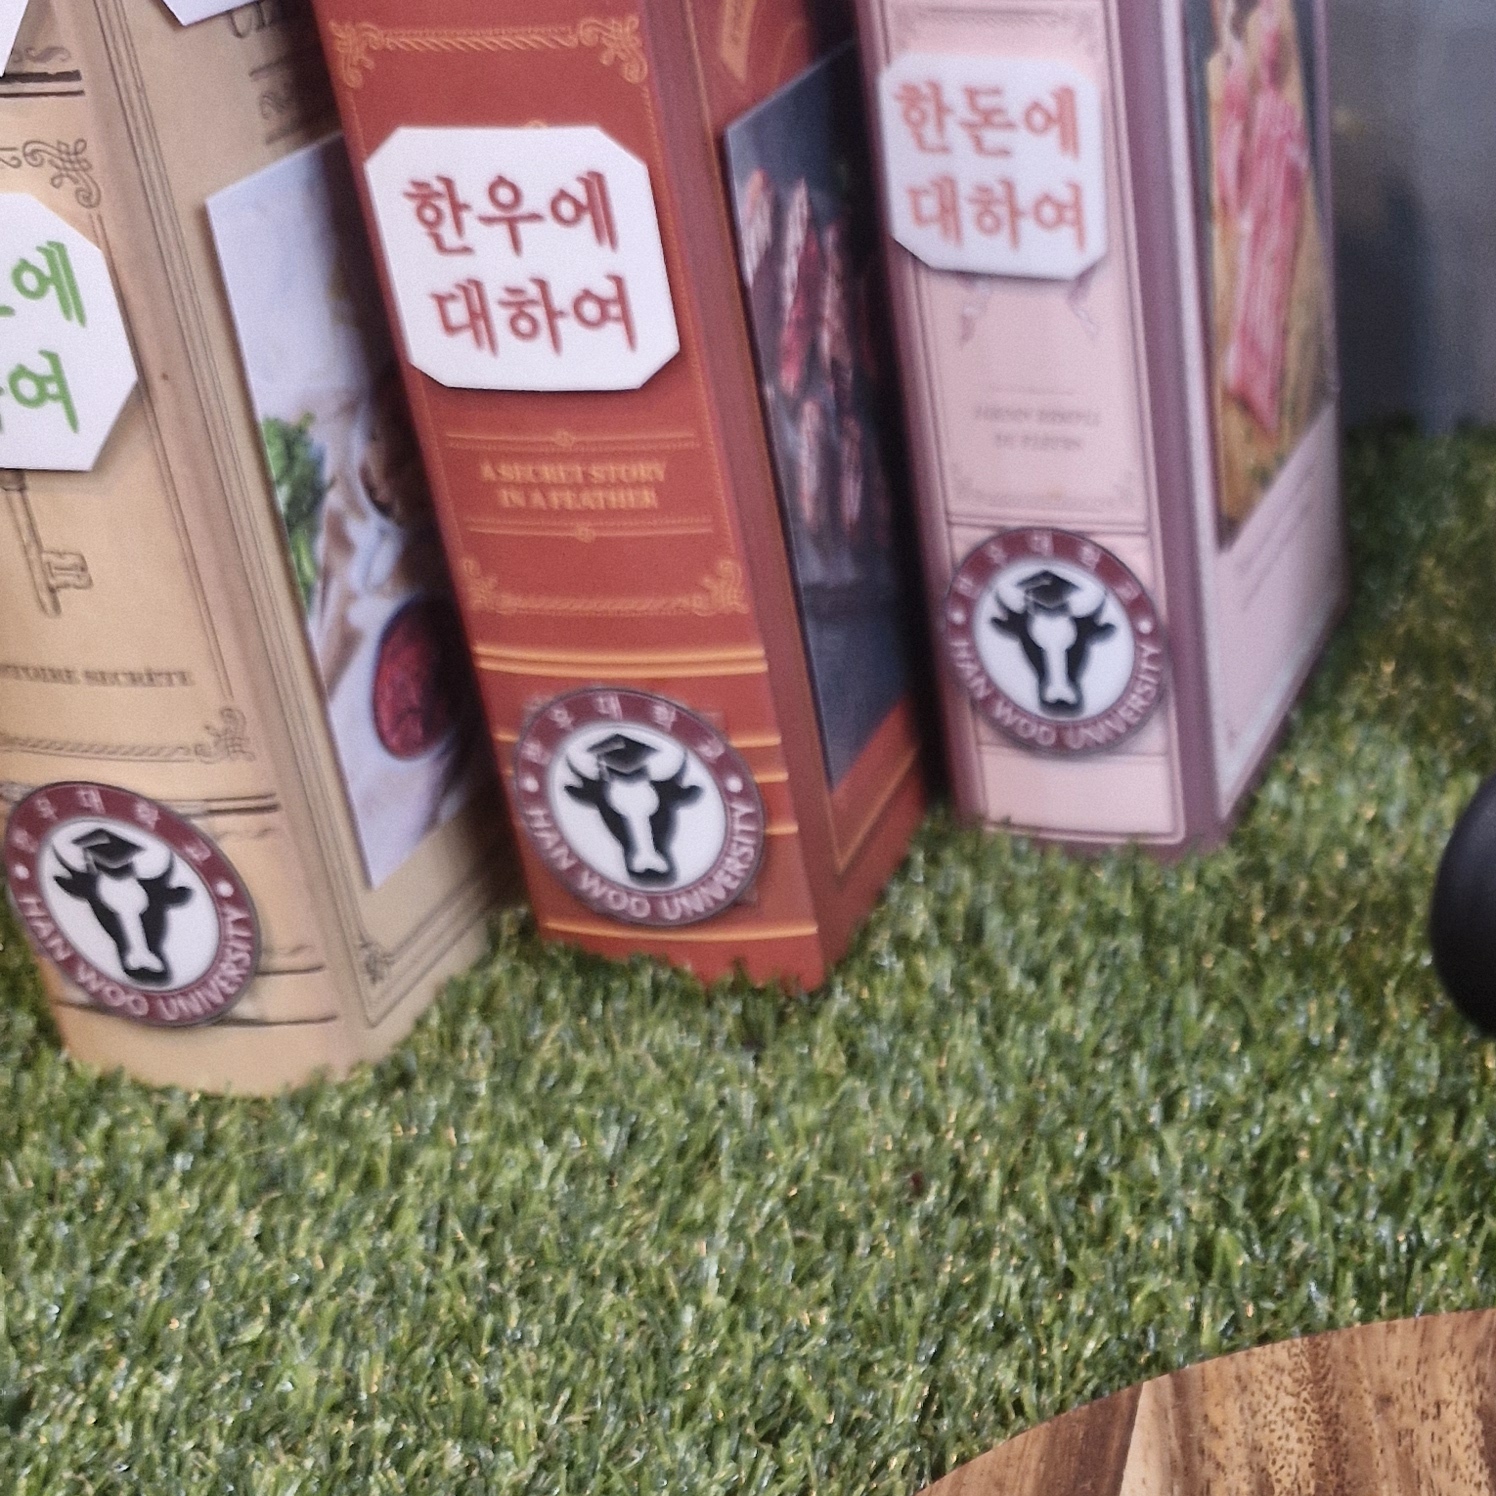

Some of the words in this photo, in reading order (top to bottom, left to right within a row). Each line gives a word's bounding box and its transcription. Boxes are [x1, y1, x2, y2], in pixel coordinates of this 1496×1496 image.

[895, 80, 1079, 161] 한돈에
[403, 170, 619, 259] 한우에
[906, 174, 1088, 252] 대하여
[430, 272, 638, 357] 대하여
[578, 868, 652, 919] WOO
[660, 800, 759, 921] UNIVERSITY
[75, 960, 151, 1017] WOO
[157, 904, 252, 1021] UNIVERSITY
